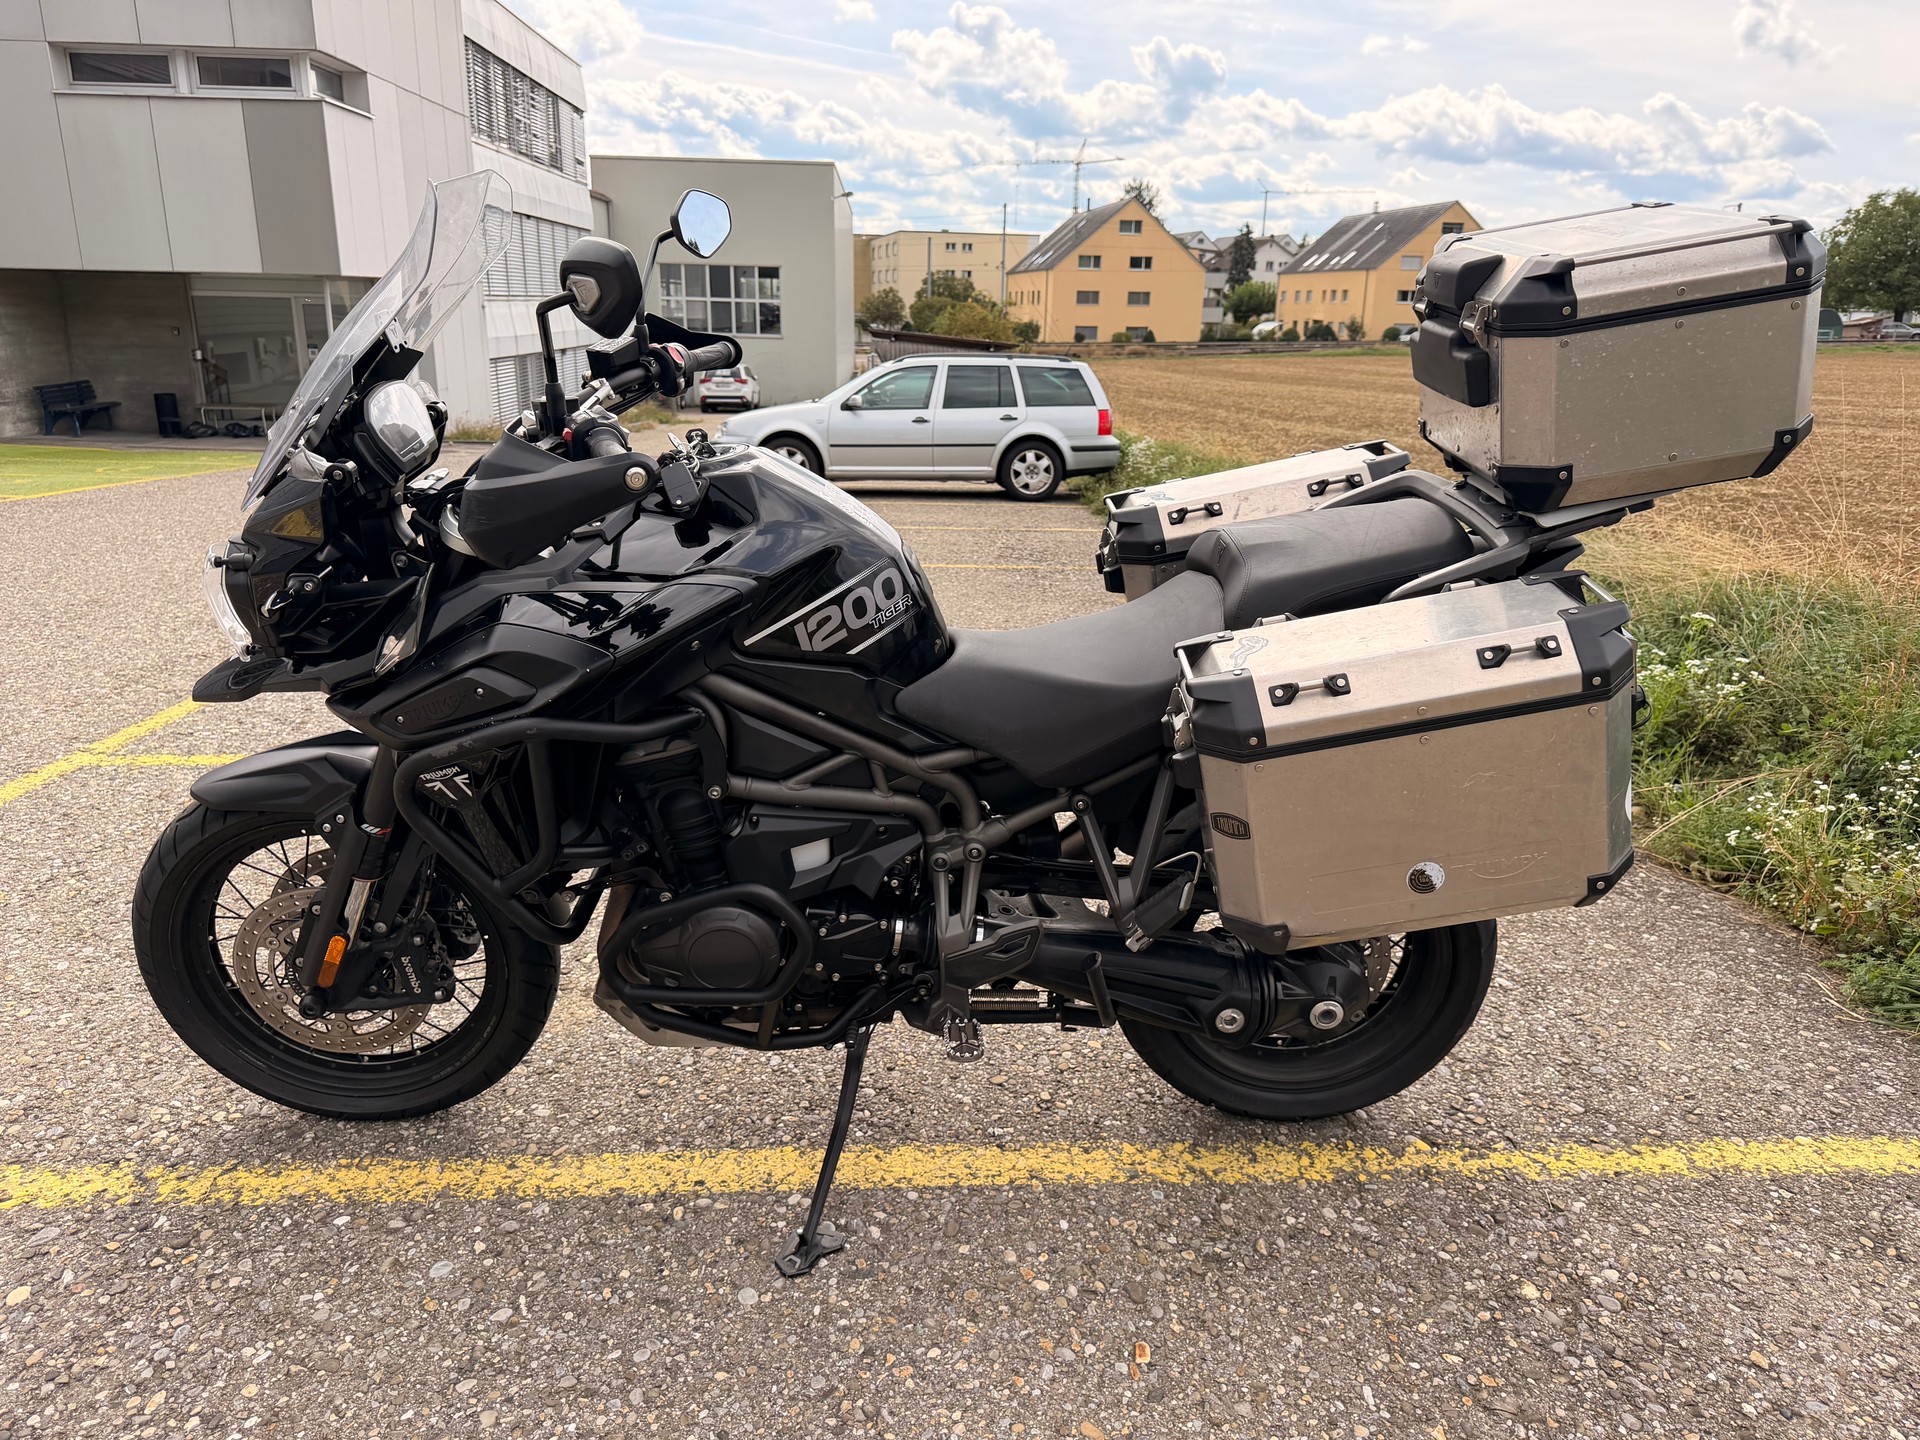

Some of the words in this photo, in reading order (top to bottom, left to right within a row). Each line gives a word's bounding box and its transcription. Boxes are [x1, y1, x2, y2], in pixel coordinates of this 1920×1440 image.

[794, 567, 904, 652] 1200
[868, 593, 913, 629] TIGER
[419, 766, 461, 780] TRIUMPH
[1216, 817, 1245, 835] TRIUMPH
[401, 955, 422, 994] brembo
